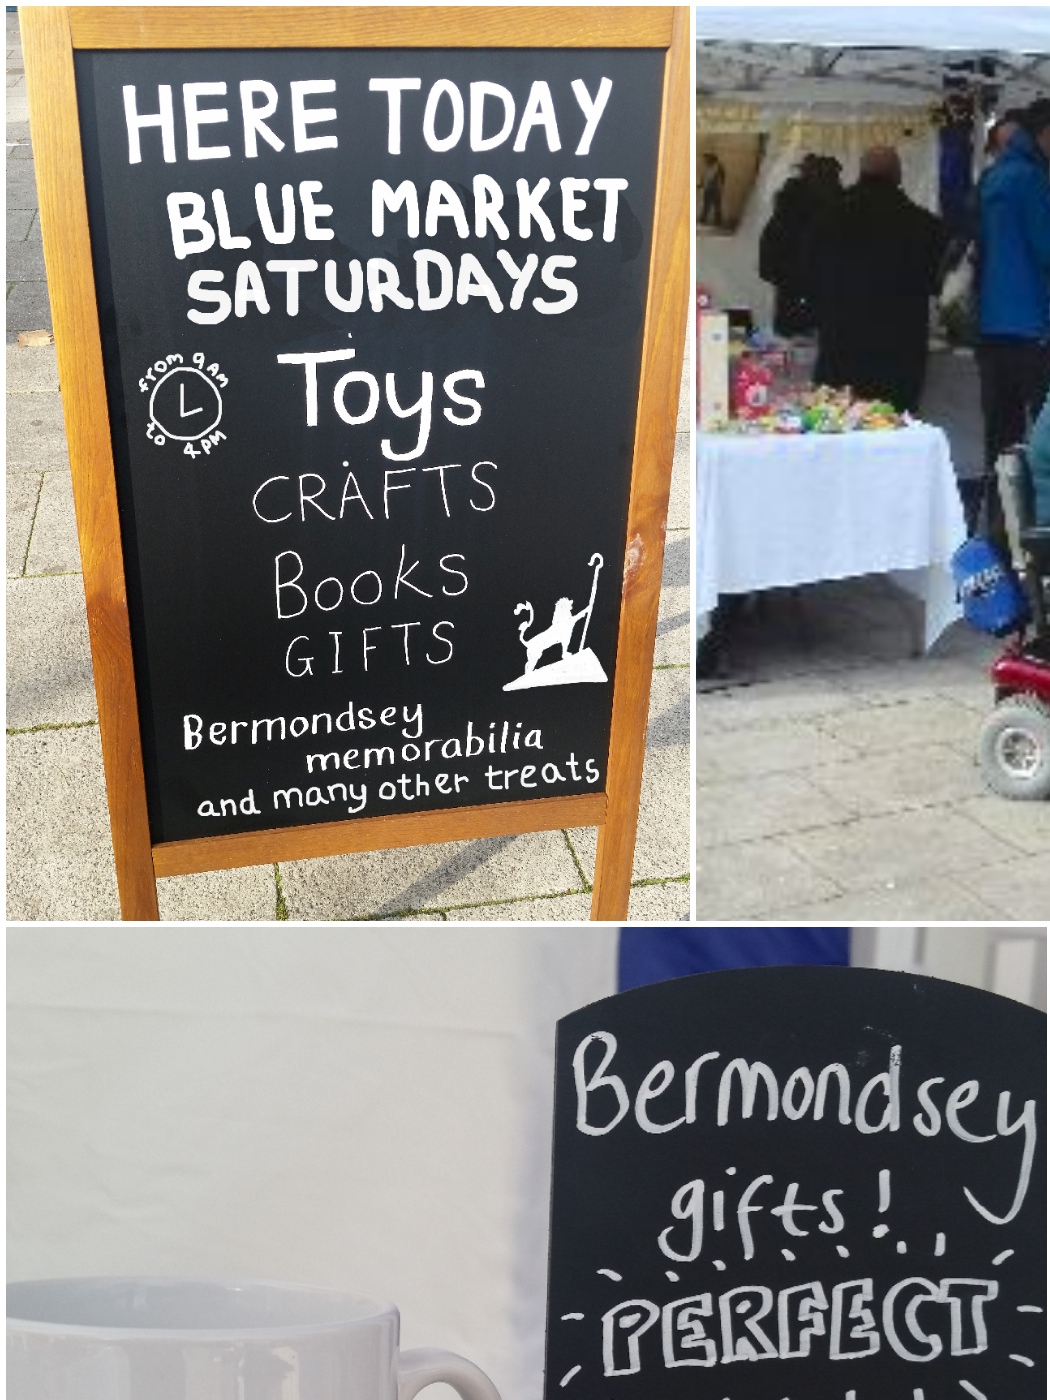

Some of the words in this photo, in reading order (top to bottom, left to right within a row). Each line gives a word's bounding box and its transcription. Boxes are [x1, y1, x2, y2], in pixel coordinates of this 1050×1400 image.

[122, 79, 338, 164] HERE
[369, 77, 612, 155] TODAY
[166, 180, 334, 259] BLUE
[371, 174, 628, 242] MARKET
[186, 248, 578, 325] SATURDAYS
[138, 353, 184, 393] from
[277, 347, 486, 461] Toys
[146, 421, 166, 446] to
[252, 461, 498, 523] CRAFTS
[274, 544, 470, 619] Books
[285, 620, 456, 677] GIFTS
[183, 701, 425, 750] Bermondsey
[306, 721, 544, 773] memorabilia
[197, 789, 261, 817] and
[273, 780, 367, 813] many
[378, 770, 469, 802] other
[485, 752, 601, 791] treats
[572, 1030, 1036, 1224] Bermondsey
[601, 1277, 998, 1377] PERFECT
